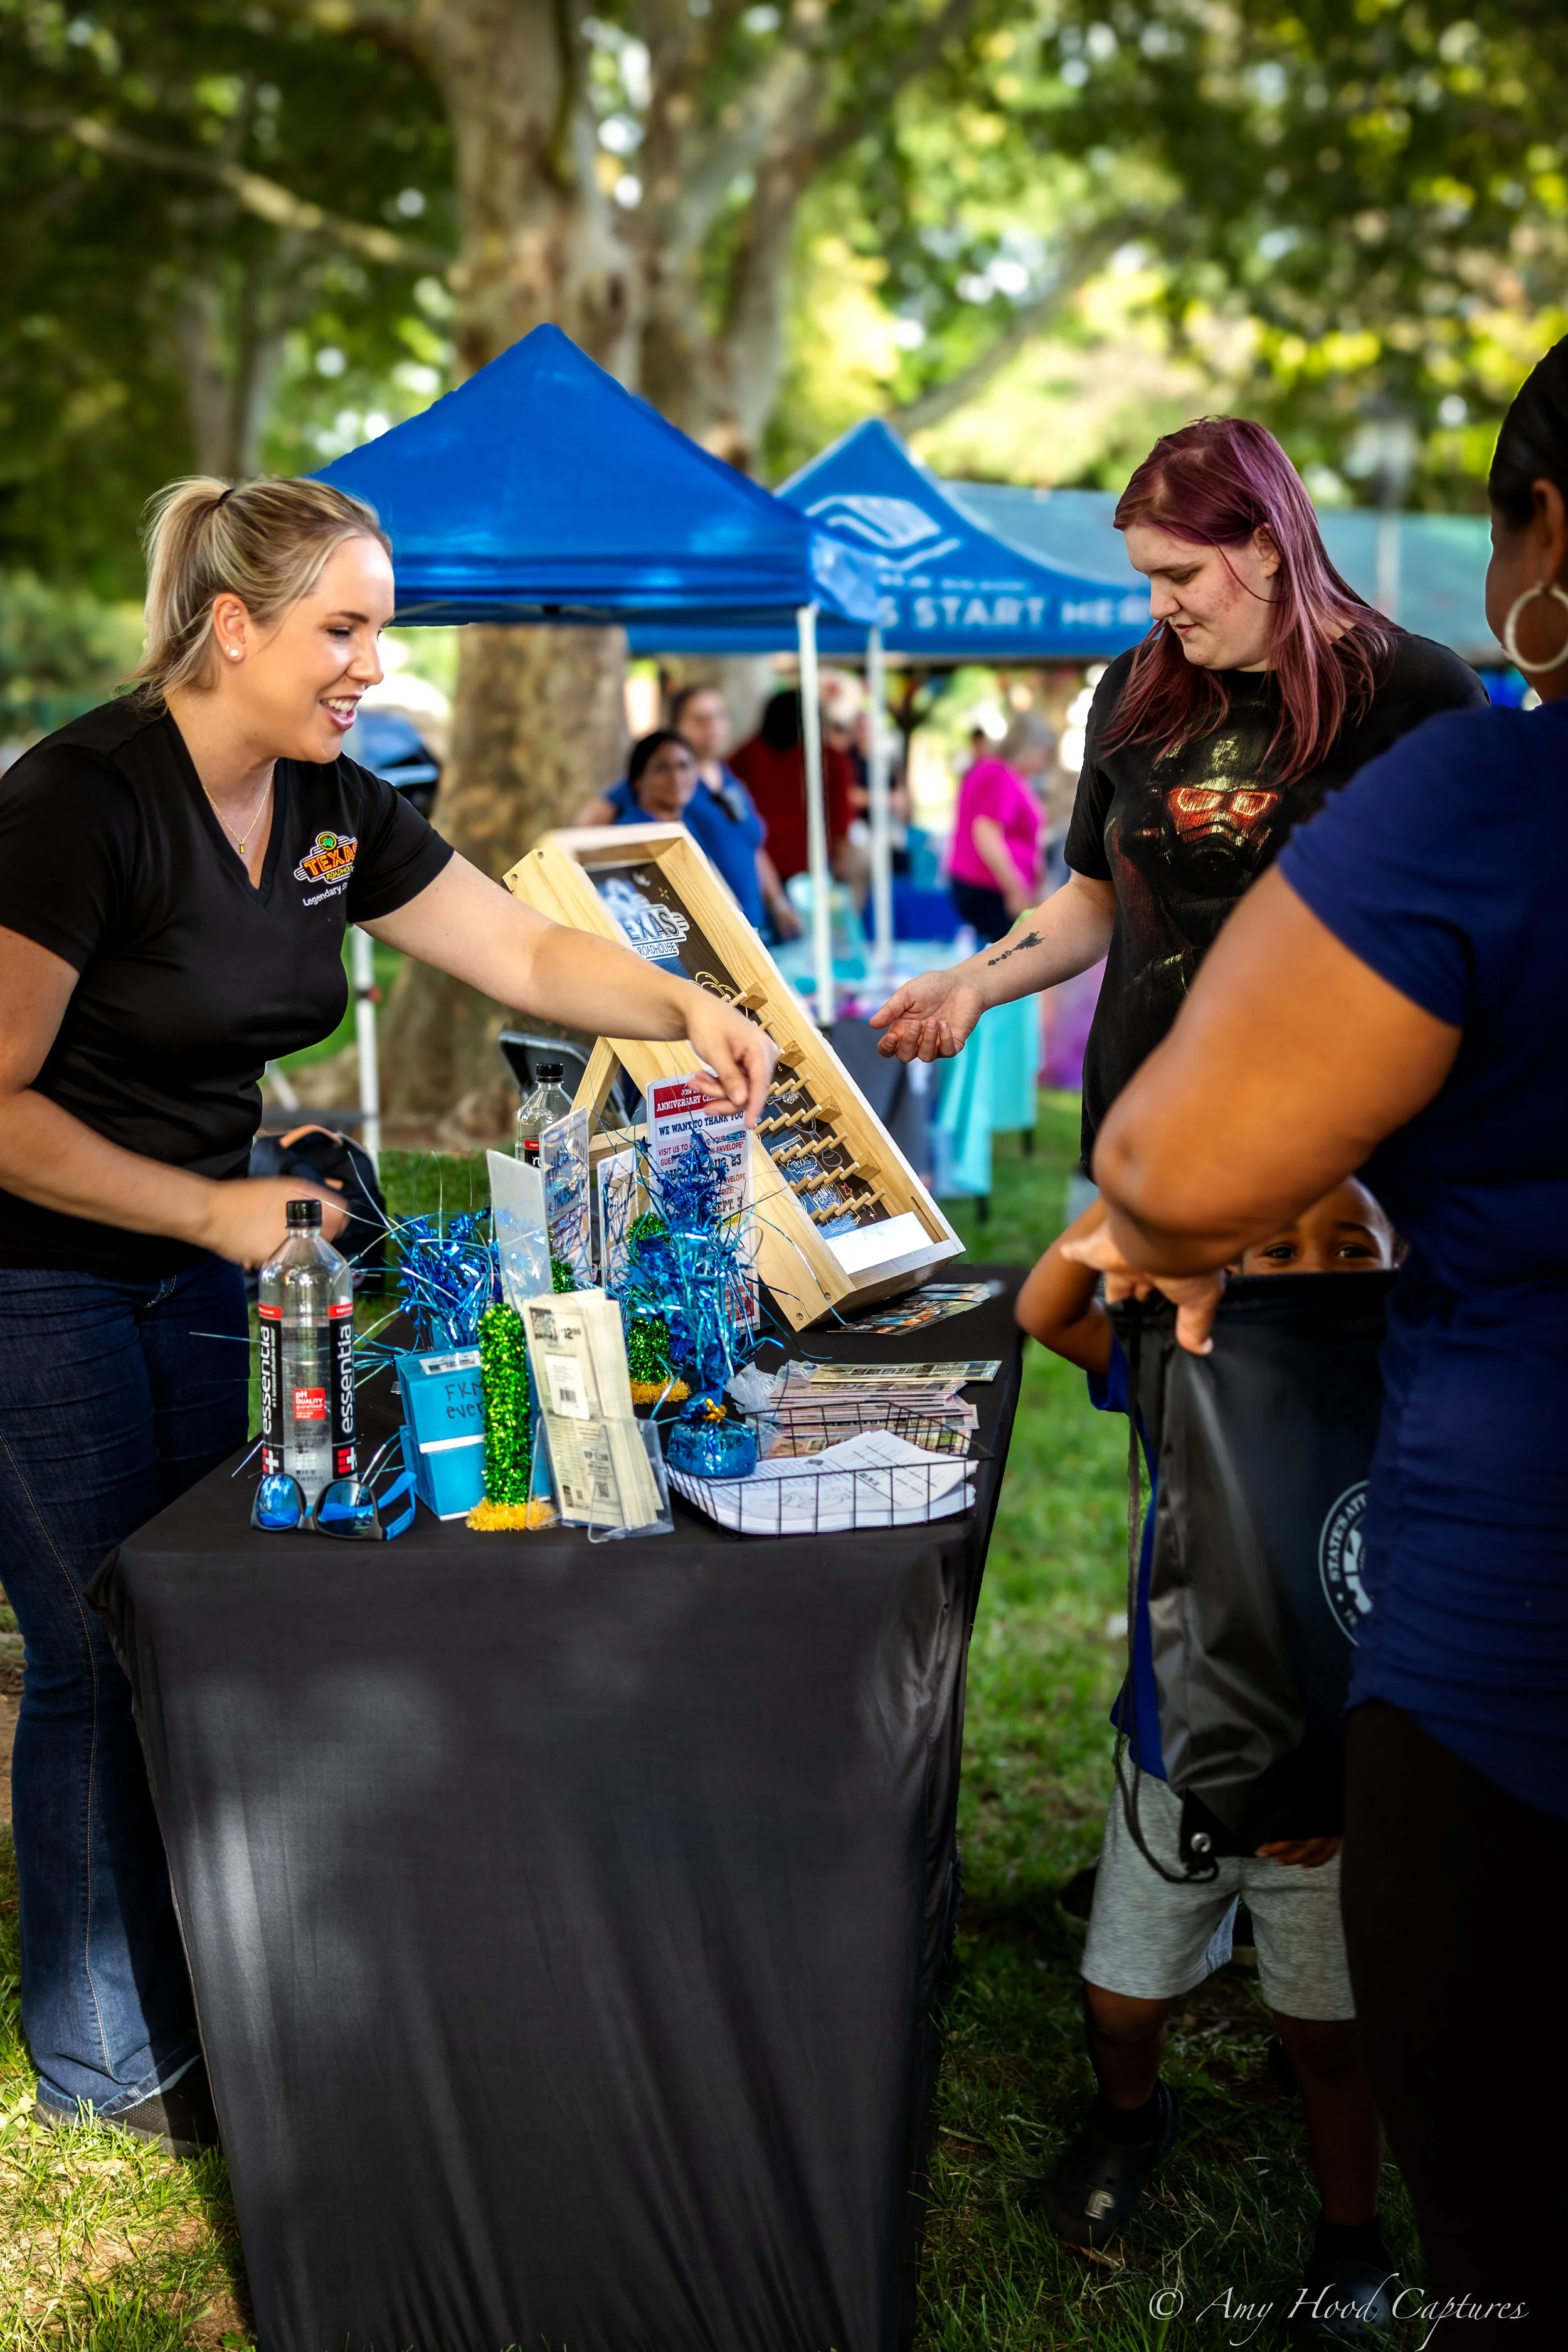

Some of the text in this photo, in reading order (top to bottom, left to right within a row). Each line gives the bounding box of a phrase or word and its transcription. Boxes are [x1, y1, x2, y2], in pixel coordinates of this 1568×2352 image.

[913, 596, 1046, 627] START
[1061, 597, 1150, 628] HER
[303, 886, 341, 906] Legendary
[624, 909, 679, 942] EXAS
[637, 942, 677, 956] ROADHOUSE
[657, 1095, 701, 1112] ANNIVERSARY
[659, 1111, 744, 1136] WE WANT TO THANK YOU
[659, 1147, 671, 1157] VISIT
[672, 1145, 679, 1153] US
[731, 1154, 741, 1167] 23
[790, 1157, 810, 1168] TEXAS
[725, 1173, 746, 1184] VELOPE
[260, 1326, 272, 1435] essentia
[337, 1324, 353, 1434] essentia
[295, 1391, 307, 1399] pH
